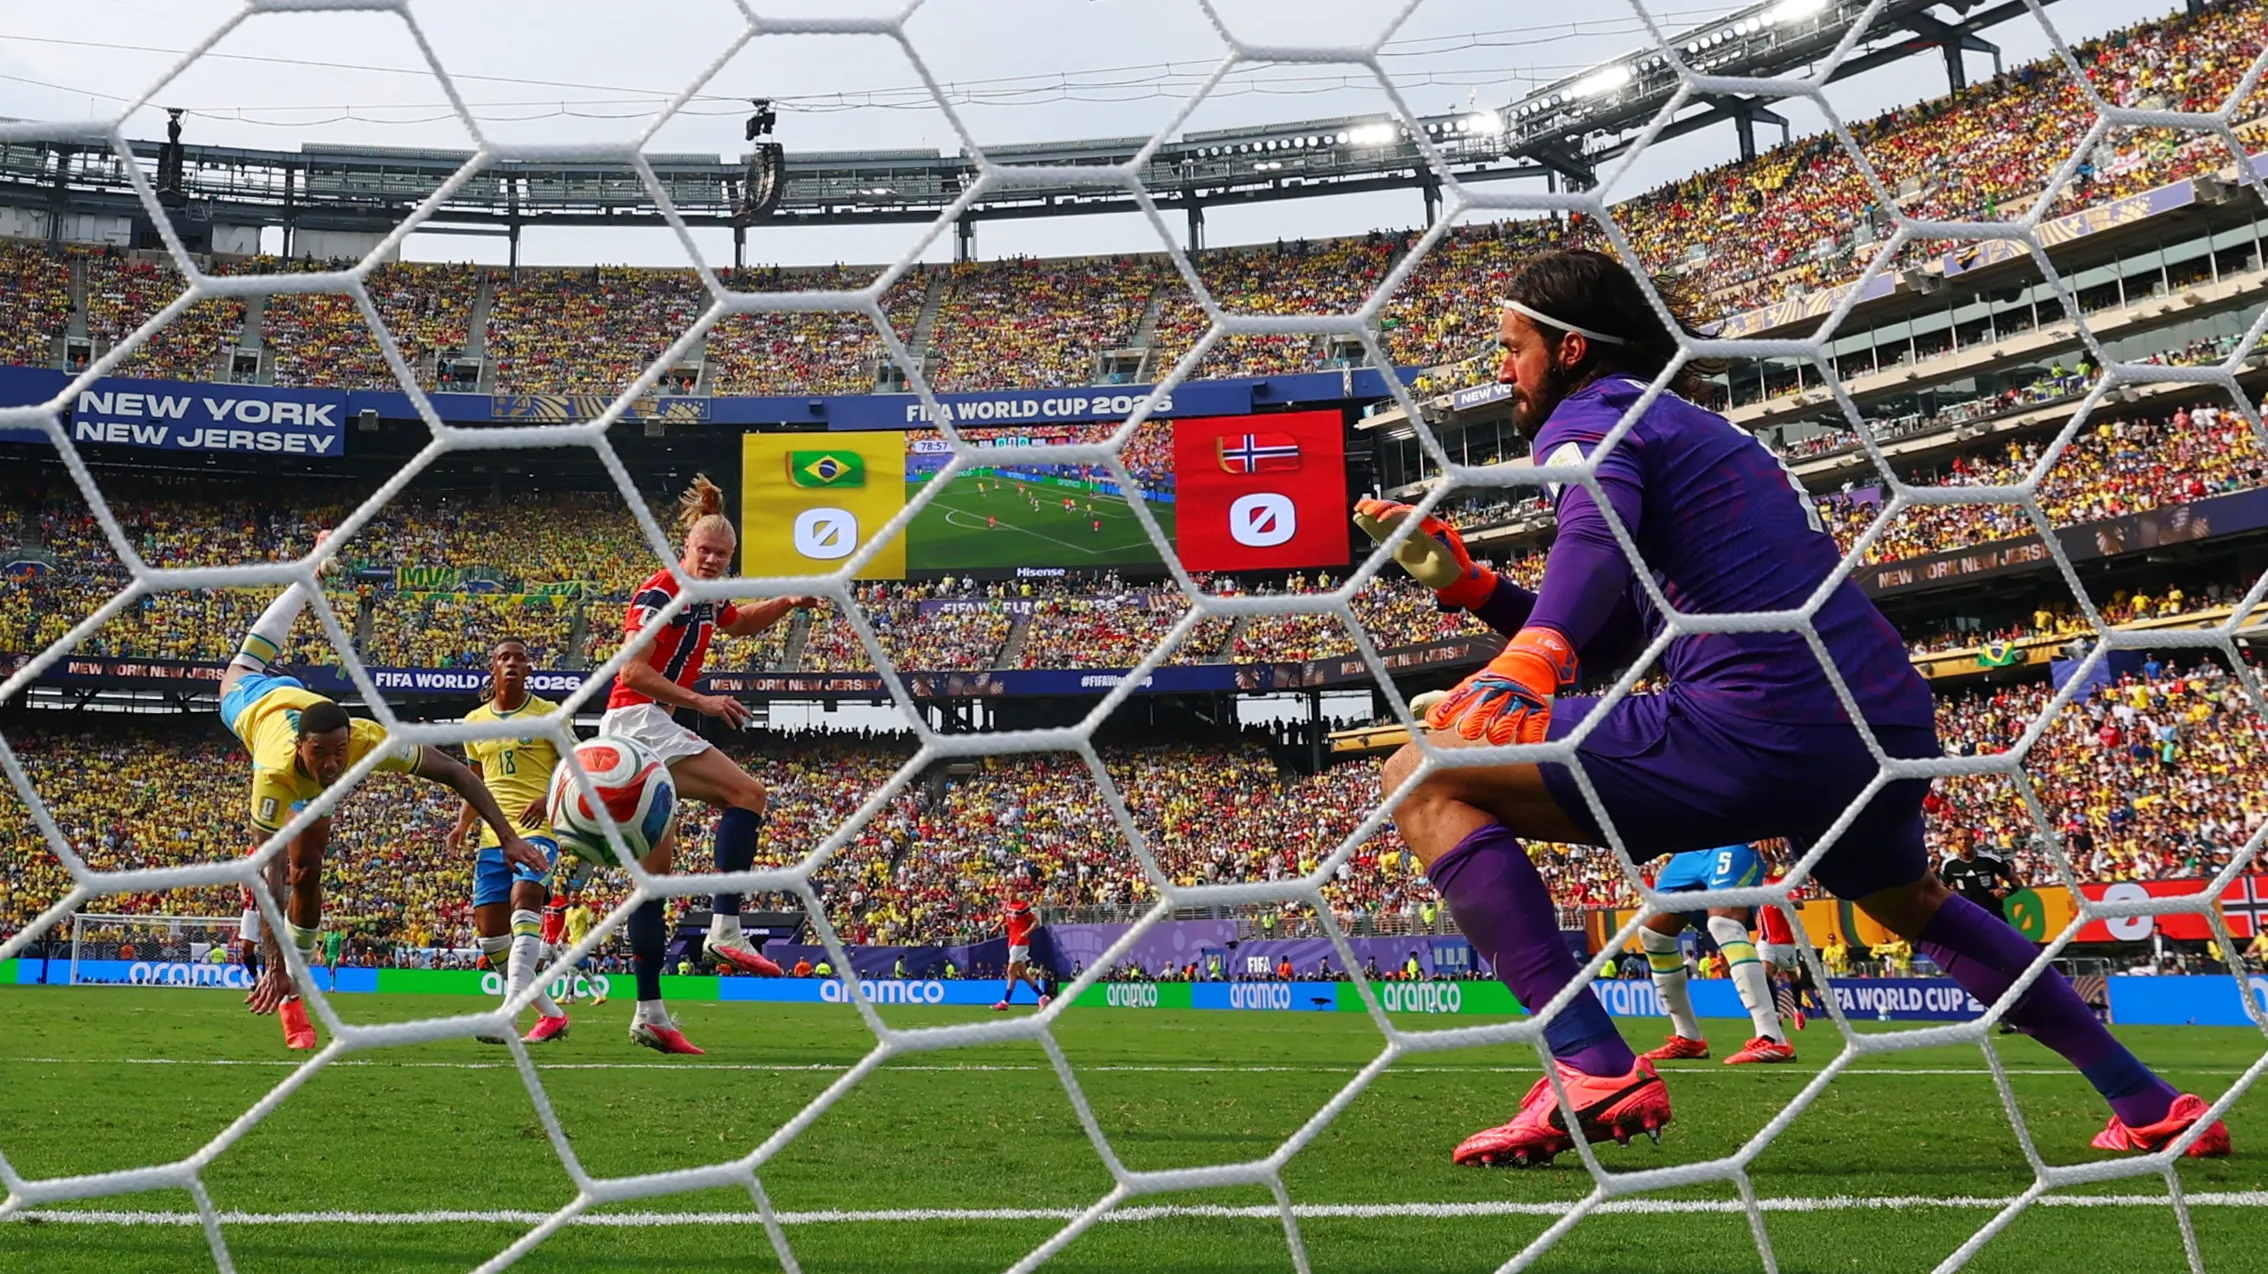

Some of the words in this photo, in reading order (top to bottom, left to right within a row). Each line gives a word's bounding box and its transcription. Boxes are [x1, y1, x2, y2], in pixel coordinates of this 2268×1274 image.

[1461, 387, 1492, 404] NEW
[1493, 383, 1513, 396] YO
[78, 391, 191, 418] NEW
[203, 397, 336, 427] YORK
[958, 400, 1039, 419] WORLD
[1043, 398, 1088, 416] CUP
[76, 422, 168, 445] NEW
[177, 428, 335, 453] JERSEY
[921, 442, 948, 451] 78:57
[1229, 493, 1296, 547] 0
[794, 507, 858, 559] 0
[1017, 567, 1065, 577] Hisense
[1878, 570, 1912, 588] NEW
[1962, 552, 1997, 573] NEW
[2000, 543, 2051, 567] JERSE
[68, 661, 102, 675] NEW
[150, 665, 185, 679] NEW
[187, 667, 227, 681] JERS
[1341, 661, 1365, 676] NEW
[1398, 652, 1423, 667] NEW
[1425, 644, 1470, 662] JERSEY
[376, 672, 413, 688] FIFA
[416, 673, 480, 689] WORLD
[710, 679, 743, 691] NEW
[789, 679, 823, 691] NEW
[825, 679, 882, 691] JERSEY
[499, 750, 516, 775] 18
[1716, 851, 1732, 875] 5
[1248, 956, 1272, 973] FIFA
[1106, 983, 1157, 1007] aramco
[1230, 983, 1291, 1009] aramco
[1383, 981, 1461, 1013] aramco
[1856, 987, 1924, 1011] WORLD
[1924, 987, 1964, 1012] CUP
